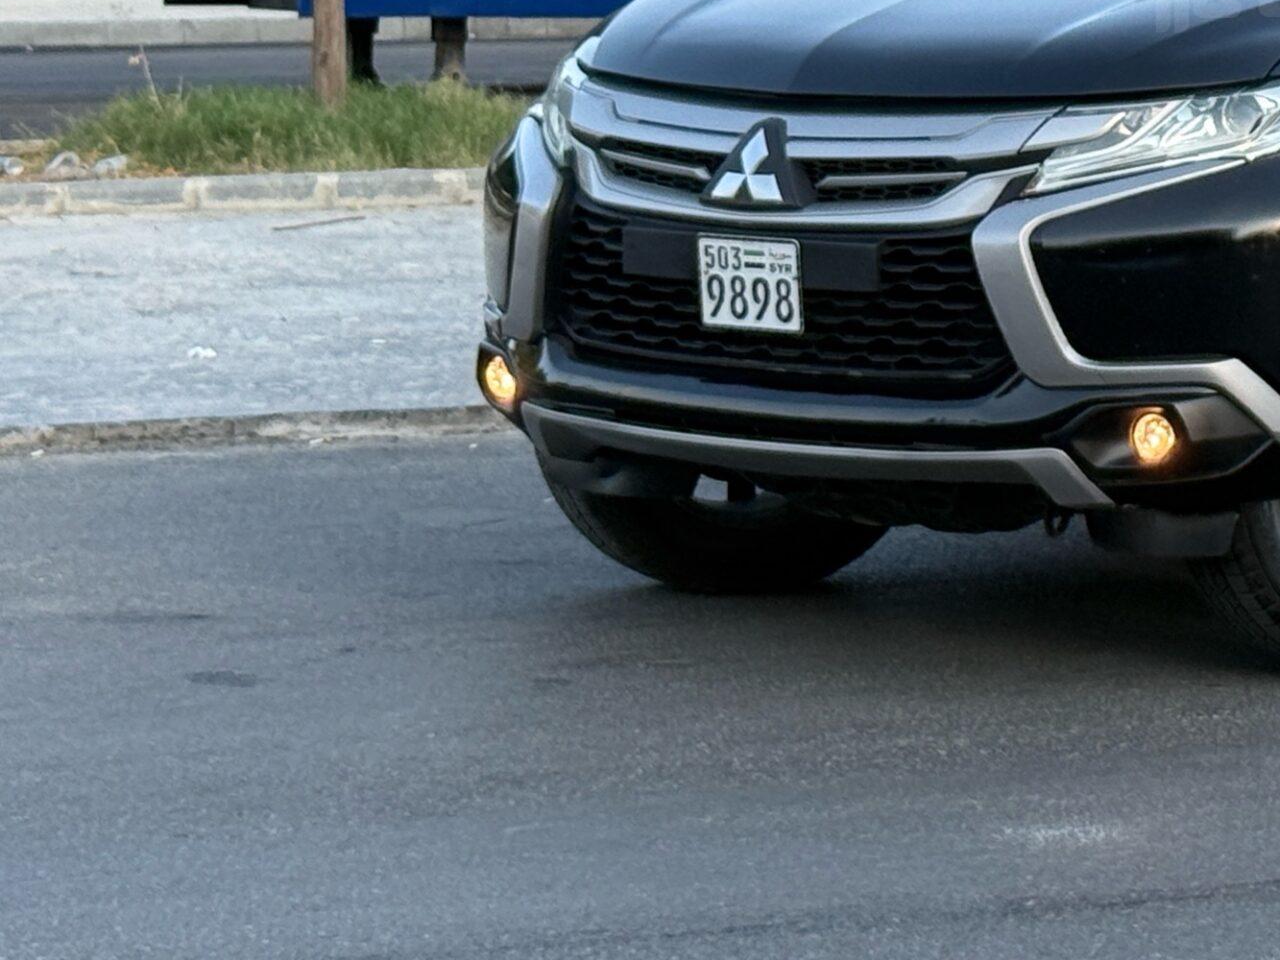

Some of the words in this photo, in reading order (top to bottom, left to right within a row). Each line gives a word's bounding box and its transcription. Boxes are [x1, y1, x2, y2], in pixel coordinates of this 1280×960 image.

[704, 244, 742, 271] 503
[769, 262, 792, 273] SYR
[706, 274, 794, 323] 9898
